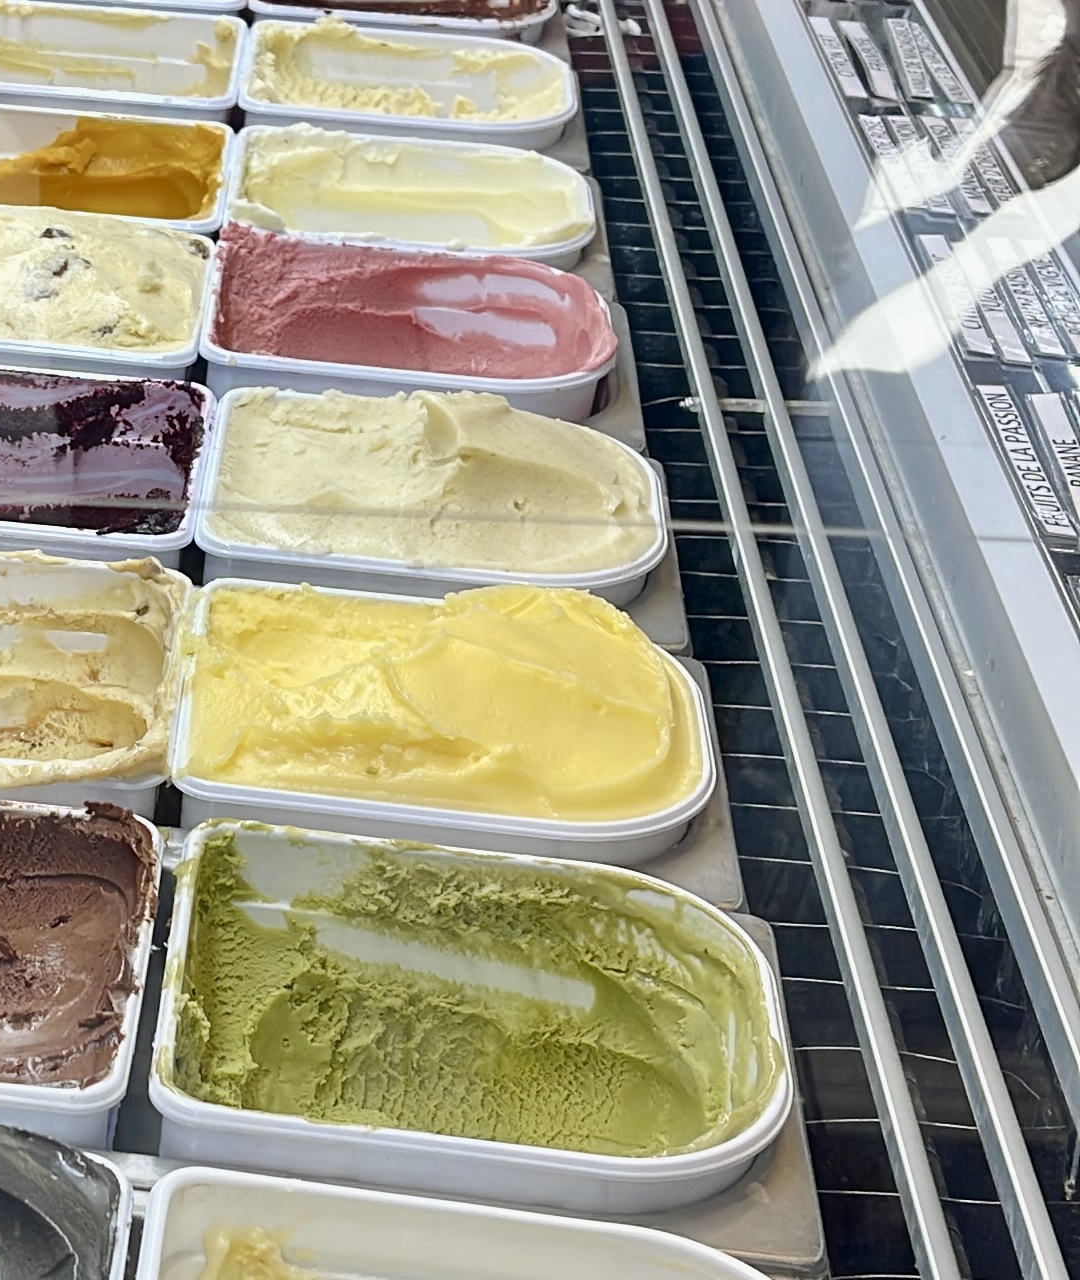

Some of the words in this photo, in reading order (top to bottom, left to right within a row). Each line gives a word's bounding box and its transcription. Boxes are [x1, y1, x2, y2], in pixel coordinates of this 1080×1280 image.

[826, 51, 856, 77] CITRON
[973, 286, 1003, 312] YUZU
[984, 392, 1029, 443] PASSION
[1007, 446, 1037, 461] LA
[1016, 464, 1047, 482] DE
[1026, 484, 1070, 527] FRUITS
